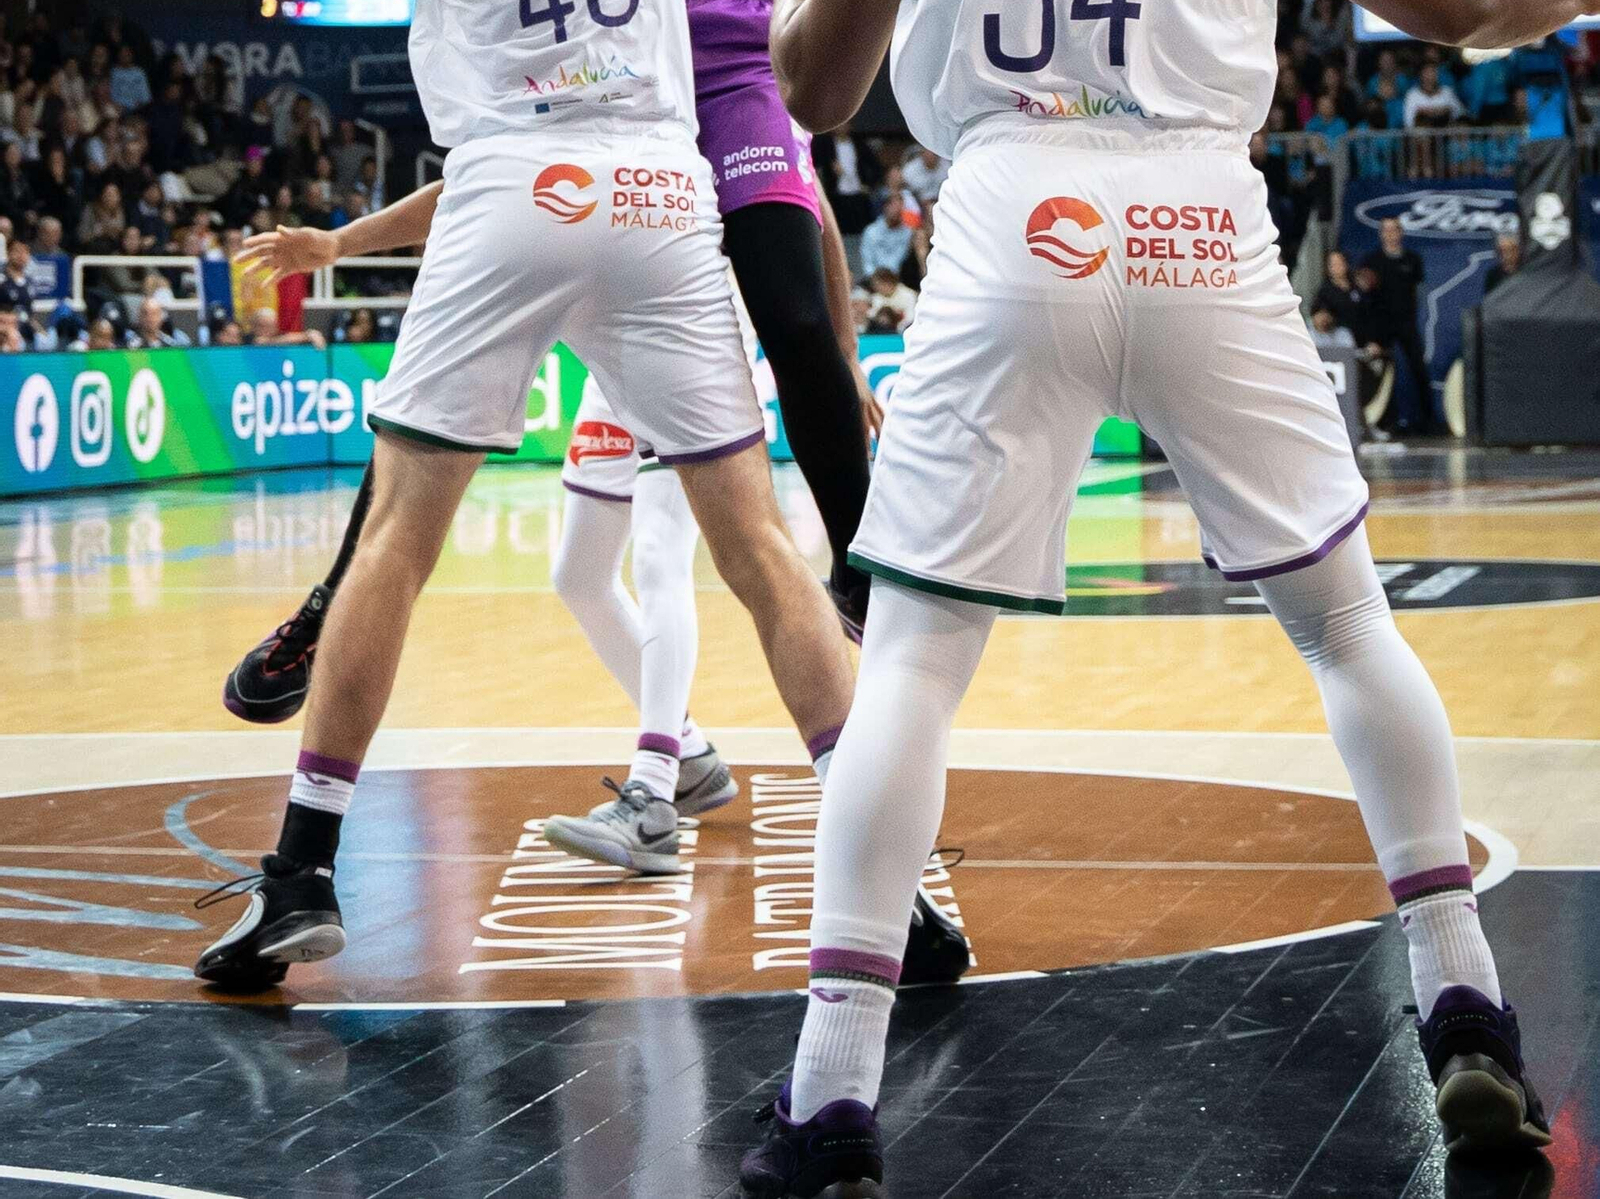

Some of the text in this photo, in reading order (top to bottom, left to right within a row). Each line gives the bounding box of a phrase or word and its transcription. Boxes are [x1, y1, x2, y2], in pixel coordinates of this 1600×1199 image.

[723, 146, 785, 166] andorra
[613, 166, 697, 197] COSTA
[724, 160, 789, 180] telecom
[613, 191, 699, 214] DEL SOL
[1125, 204, 1237, 236] COSTA
[1126, 237, 1239, 262] DEL SOL
[1126, 261, 1239, 288] MÁLAGA
